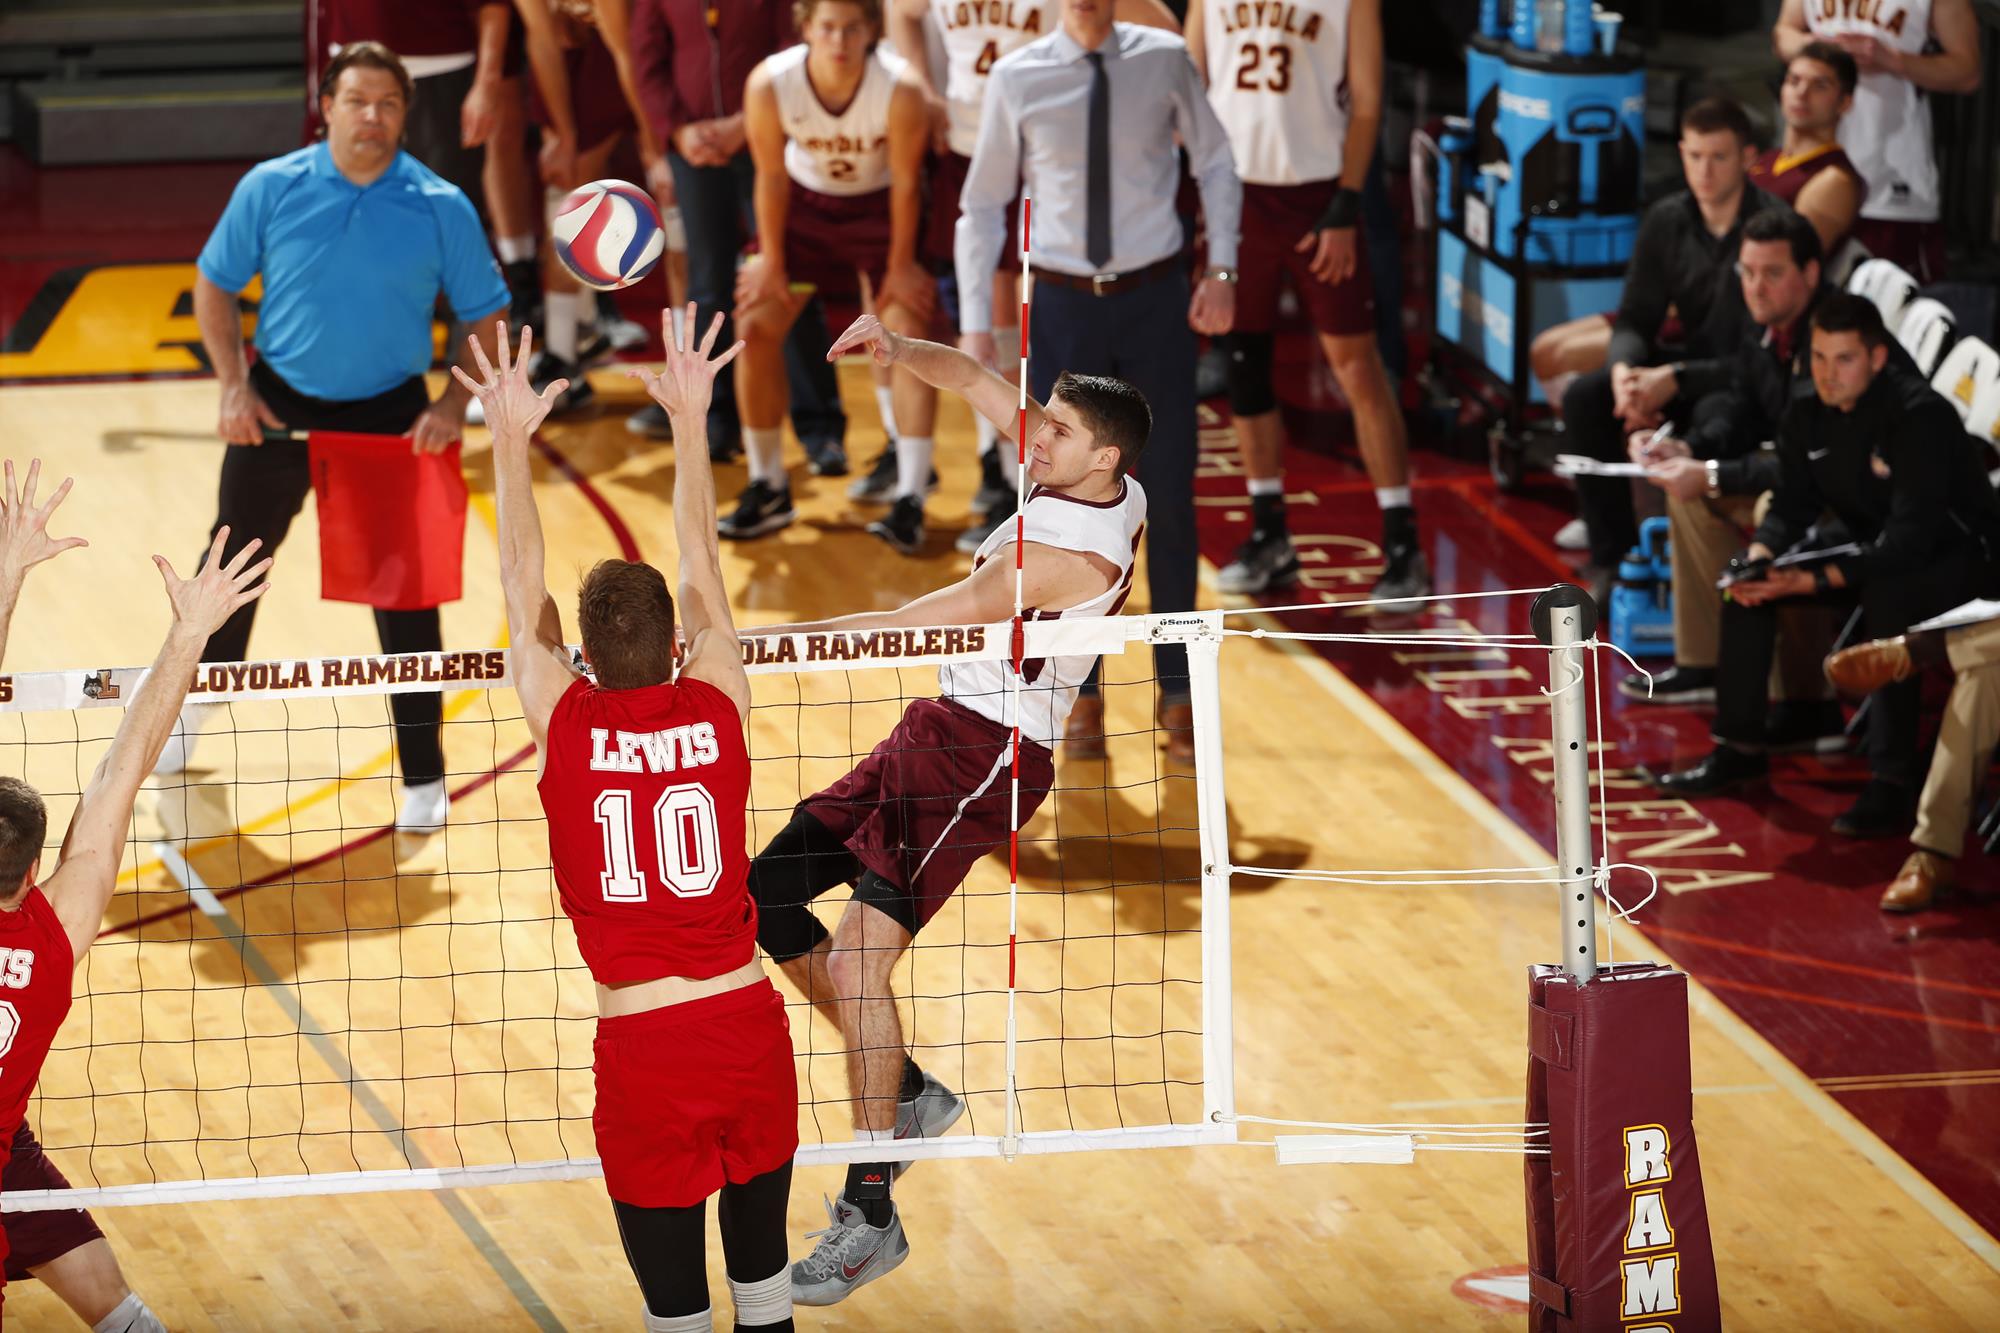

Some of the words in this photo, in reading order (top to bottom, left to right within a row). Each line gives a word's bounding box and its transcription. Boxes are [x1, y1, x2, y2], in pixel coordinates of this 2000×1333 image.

[1219, 0, 1324, 42] LOYOLA
[974, 39, 999, 75] 4
[1236, 42, 1292, 95] 23
[828, 158, 857, 182] 2
[1168, 618, 1204, 626] Senoh
[806, 626, 986, 662] RAMBLERS
[188, 657, 312, 694] LOYOLA
[321, 651, 506, 687] RAMBLERS
[589, 721, 720, 773] LEWIS
[593, 781, 723, 902] 10
[1619, 1123, 1682, 1333] RAM
